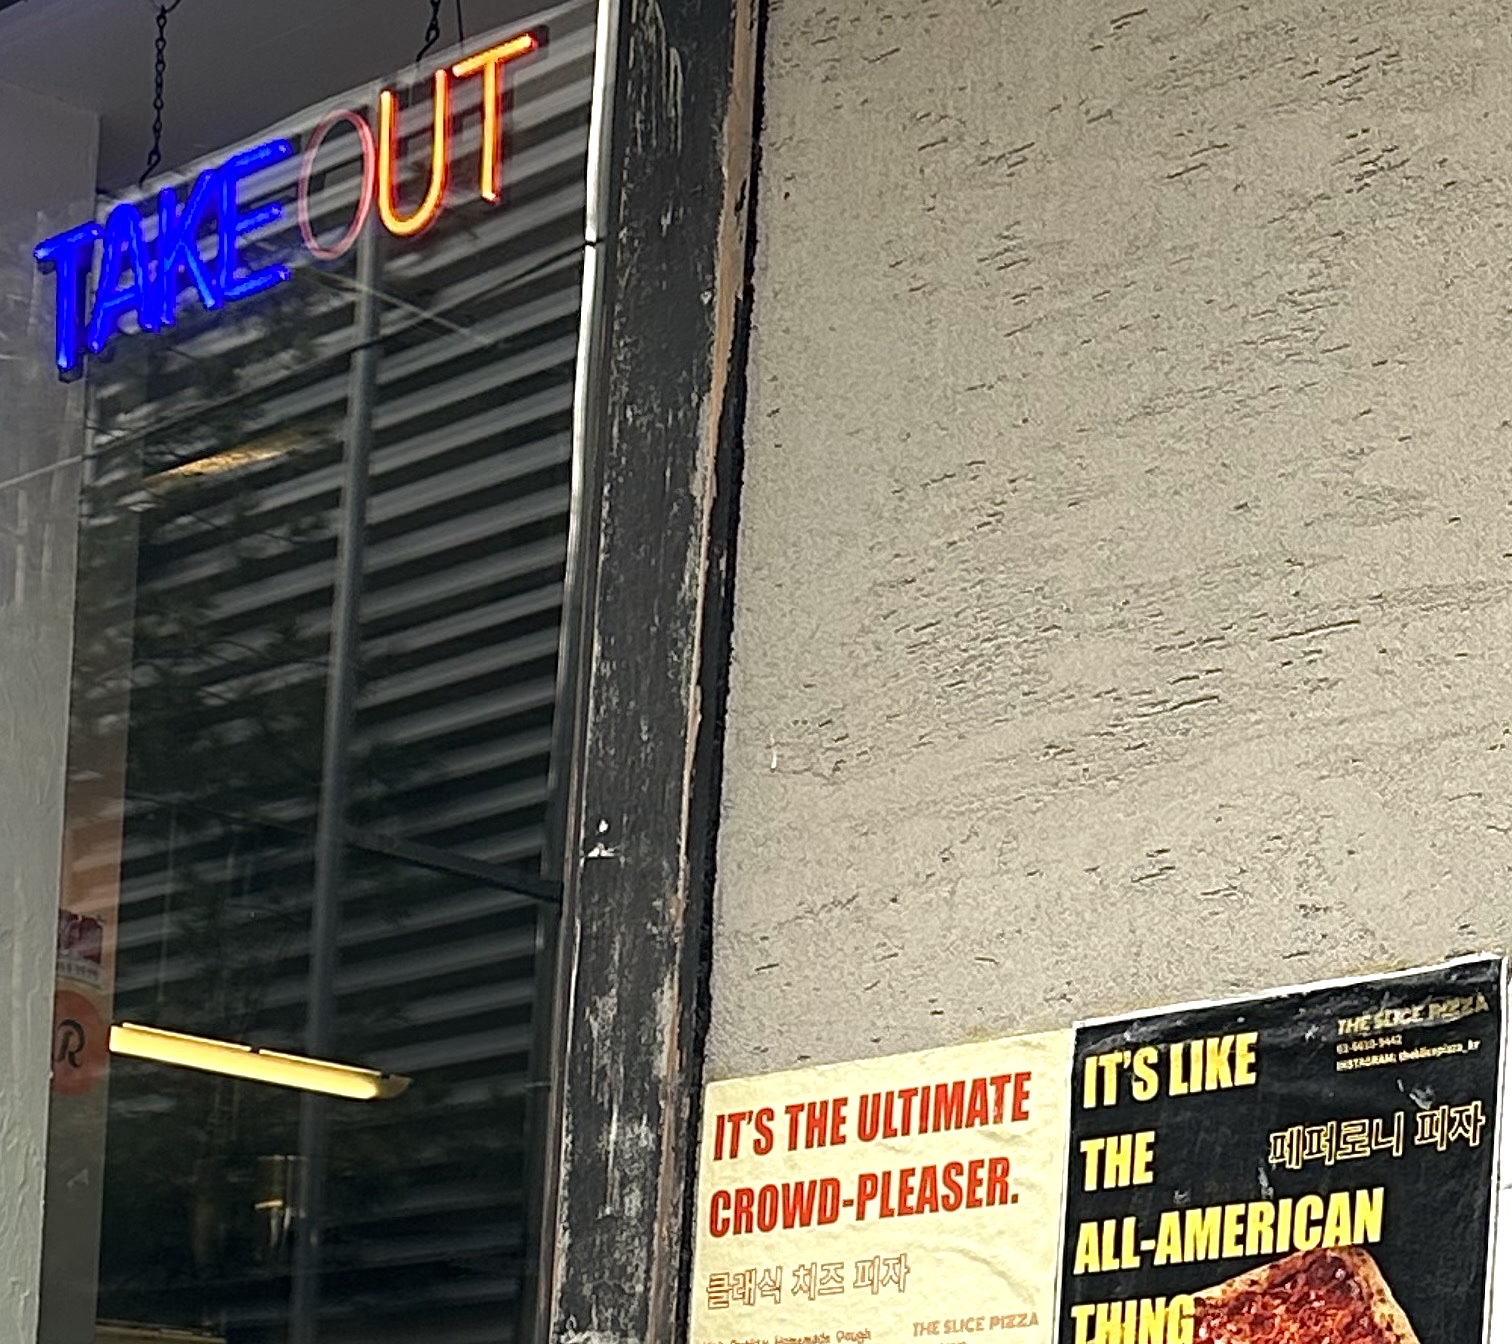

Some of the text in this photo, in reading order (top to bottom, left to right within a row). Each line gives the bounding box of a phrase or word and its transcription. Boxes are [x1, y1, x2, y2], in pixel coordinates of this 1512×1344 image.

[35, 33, 538, 371] TAKE OUT
[1338, 1014, 1372, 1035] THE
[1083, 1031, 1259, 1110] IT'S LIKE
[713, 1071, 1032, 1160] IT'S THE ULTIMATE
[1268, 1101, 1485, 1170] 페퍼로니 피자
[709, 1157, 1019, 1237] CROWD-PLEASER.
[1080, 1130, 1156, 1192] THE
[1072, 1186, 1386, 1275] ALL-AMERICAN
[707, 1253, 909, 1310] 클래식 치즈 피자
[913, 1312, 1039, 1337] THE SLICE PIZZA
